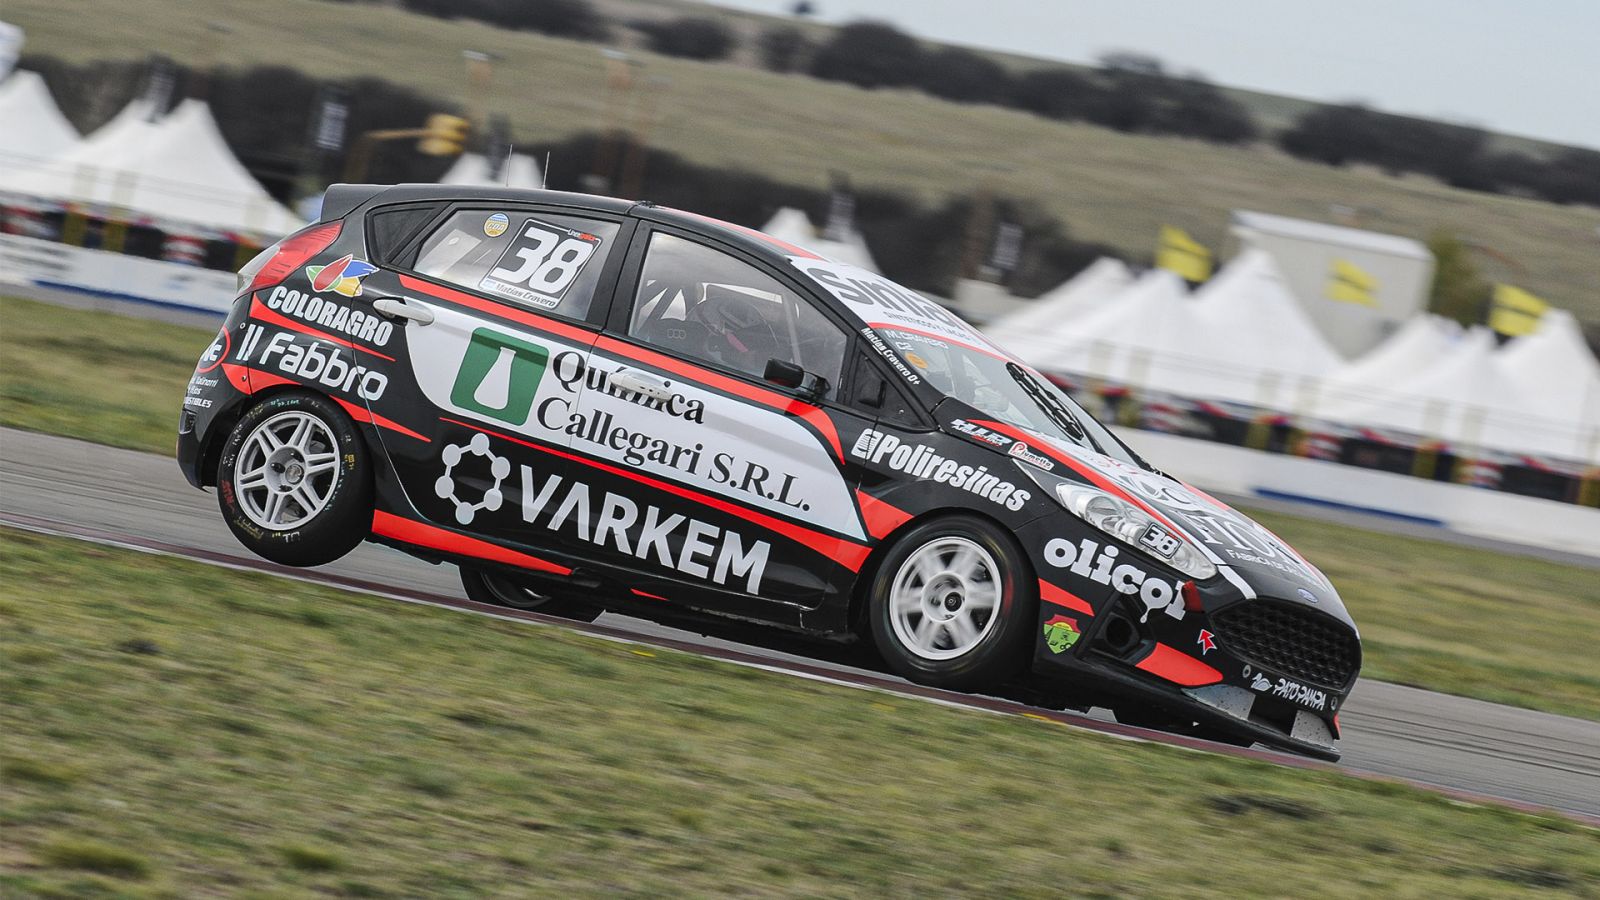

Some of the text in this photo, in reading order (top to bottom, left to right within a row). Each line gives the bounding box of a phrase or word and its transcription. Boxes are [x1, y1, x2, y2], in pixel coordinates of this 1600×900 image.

[490, 227, 594, 294] 38
[267, 285, 393, 347] COLORAGRO
[259, 332, 388, 401] Fabbro
[883, 349, 911, 377] Cravero
[537, 397, 811, 512] Callegari S.R.L.
[871, 435, 1031, 511] Poliresinas
[520, 464, 771, 595] VARKEM
[1140, 526, 1179, 555] 38
